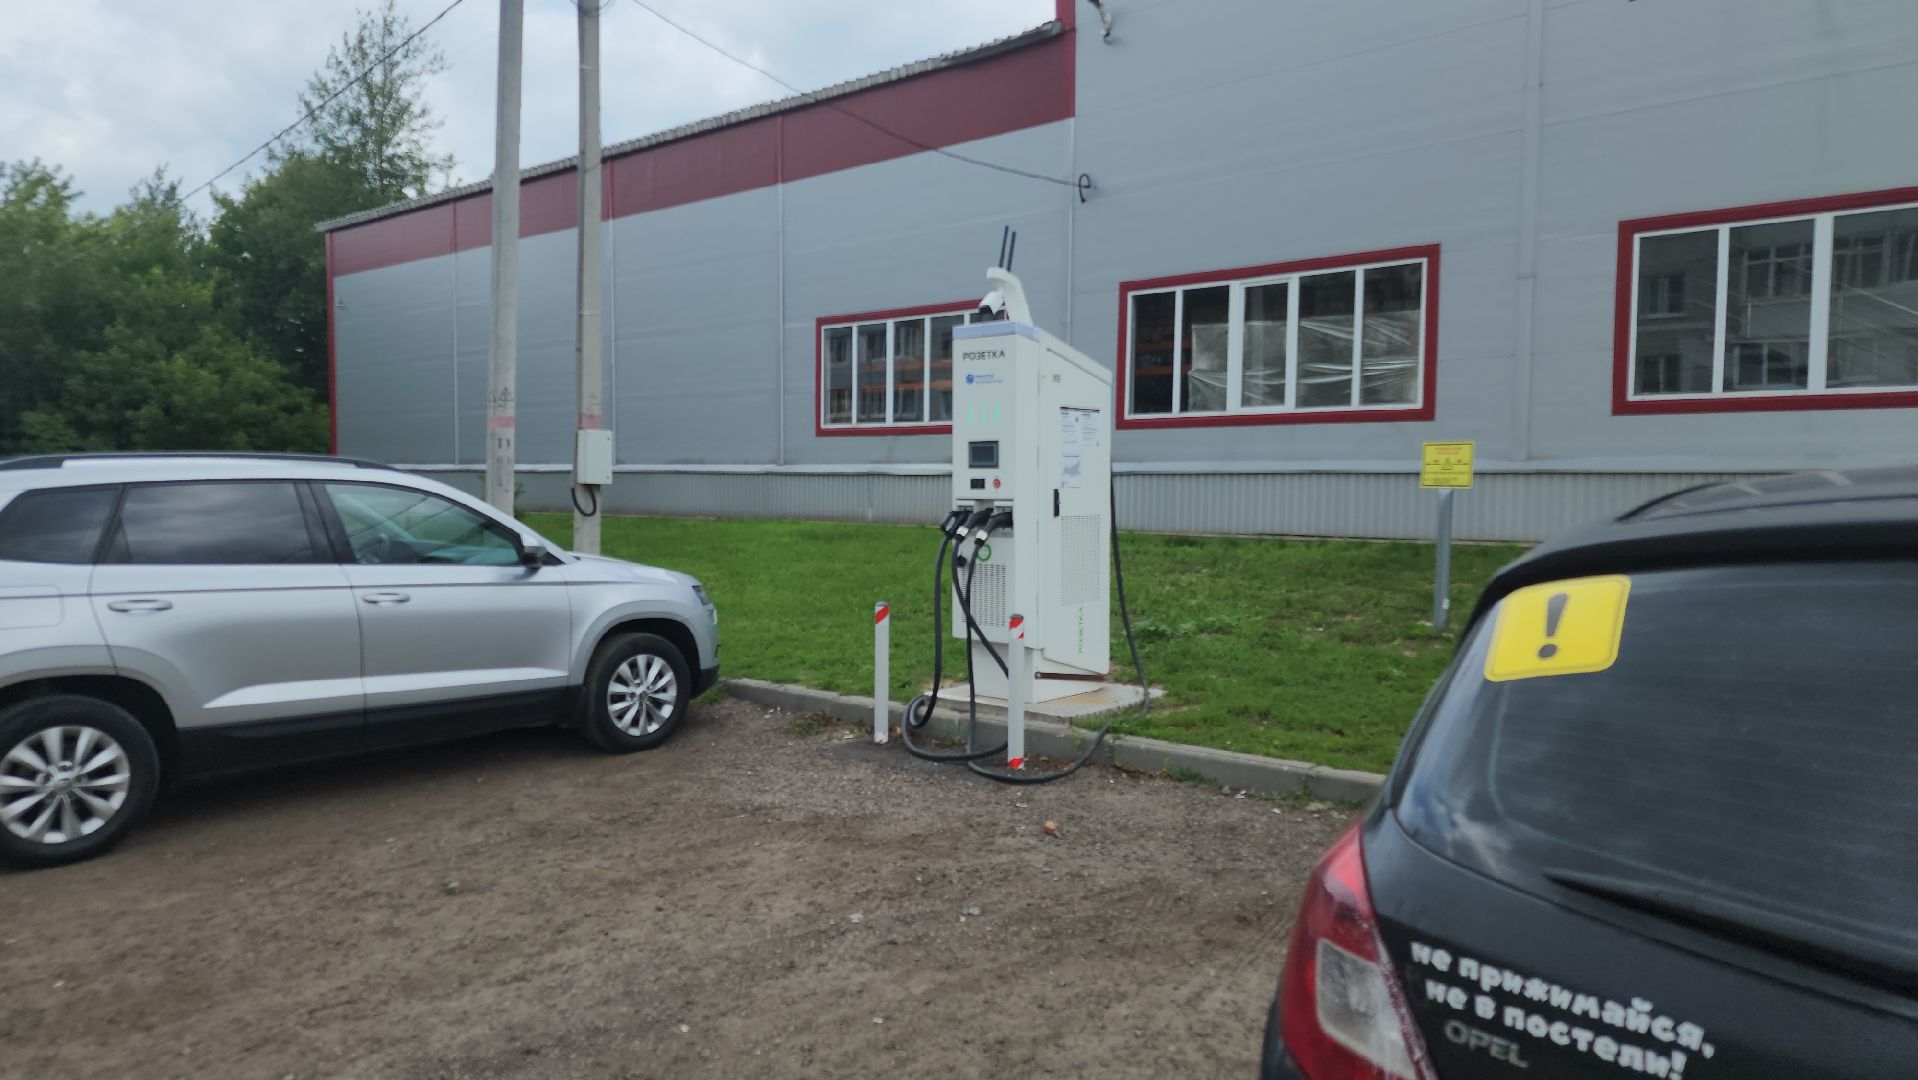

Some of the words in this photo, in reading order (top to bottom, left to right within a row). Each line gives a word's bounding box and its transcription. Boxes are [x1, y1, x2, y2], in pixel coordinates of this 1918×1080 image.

[962, 350, 1005, 361] РОЗЕТКА
[1410, 940, 1453, 973] не
[1457, 956, 1716, 1059] прижимайся,
[1424, 978, 1469, 1011] не
[1473, 993, 1497, 1020] в
[1502, 1005, 1688, 1080] постели!
[1443, 1018, 1530, 1068] OPEL
